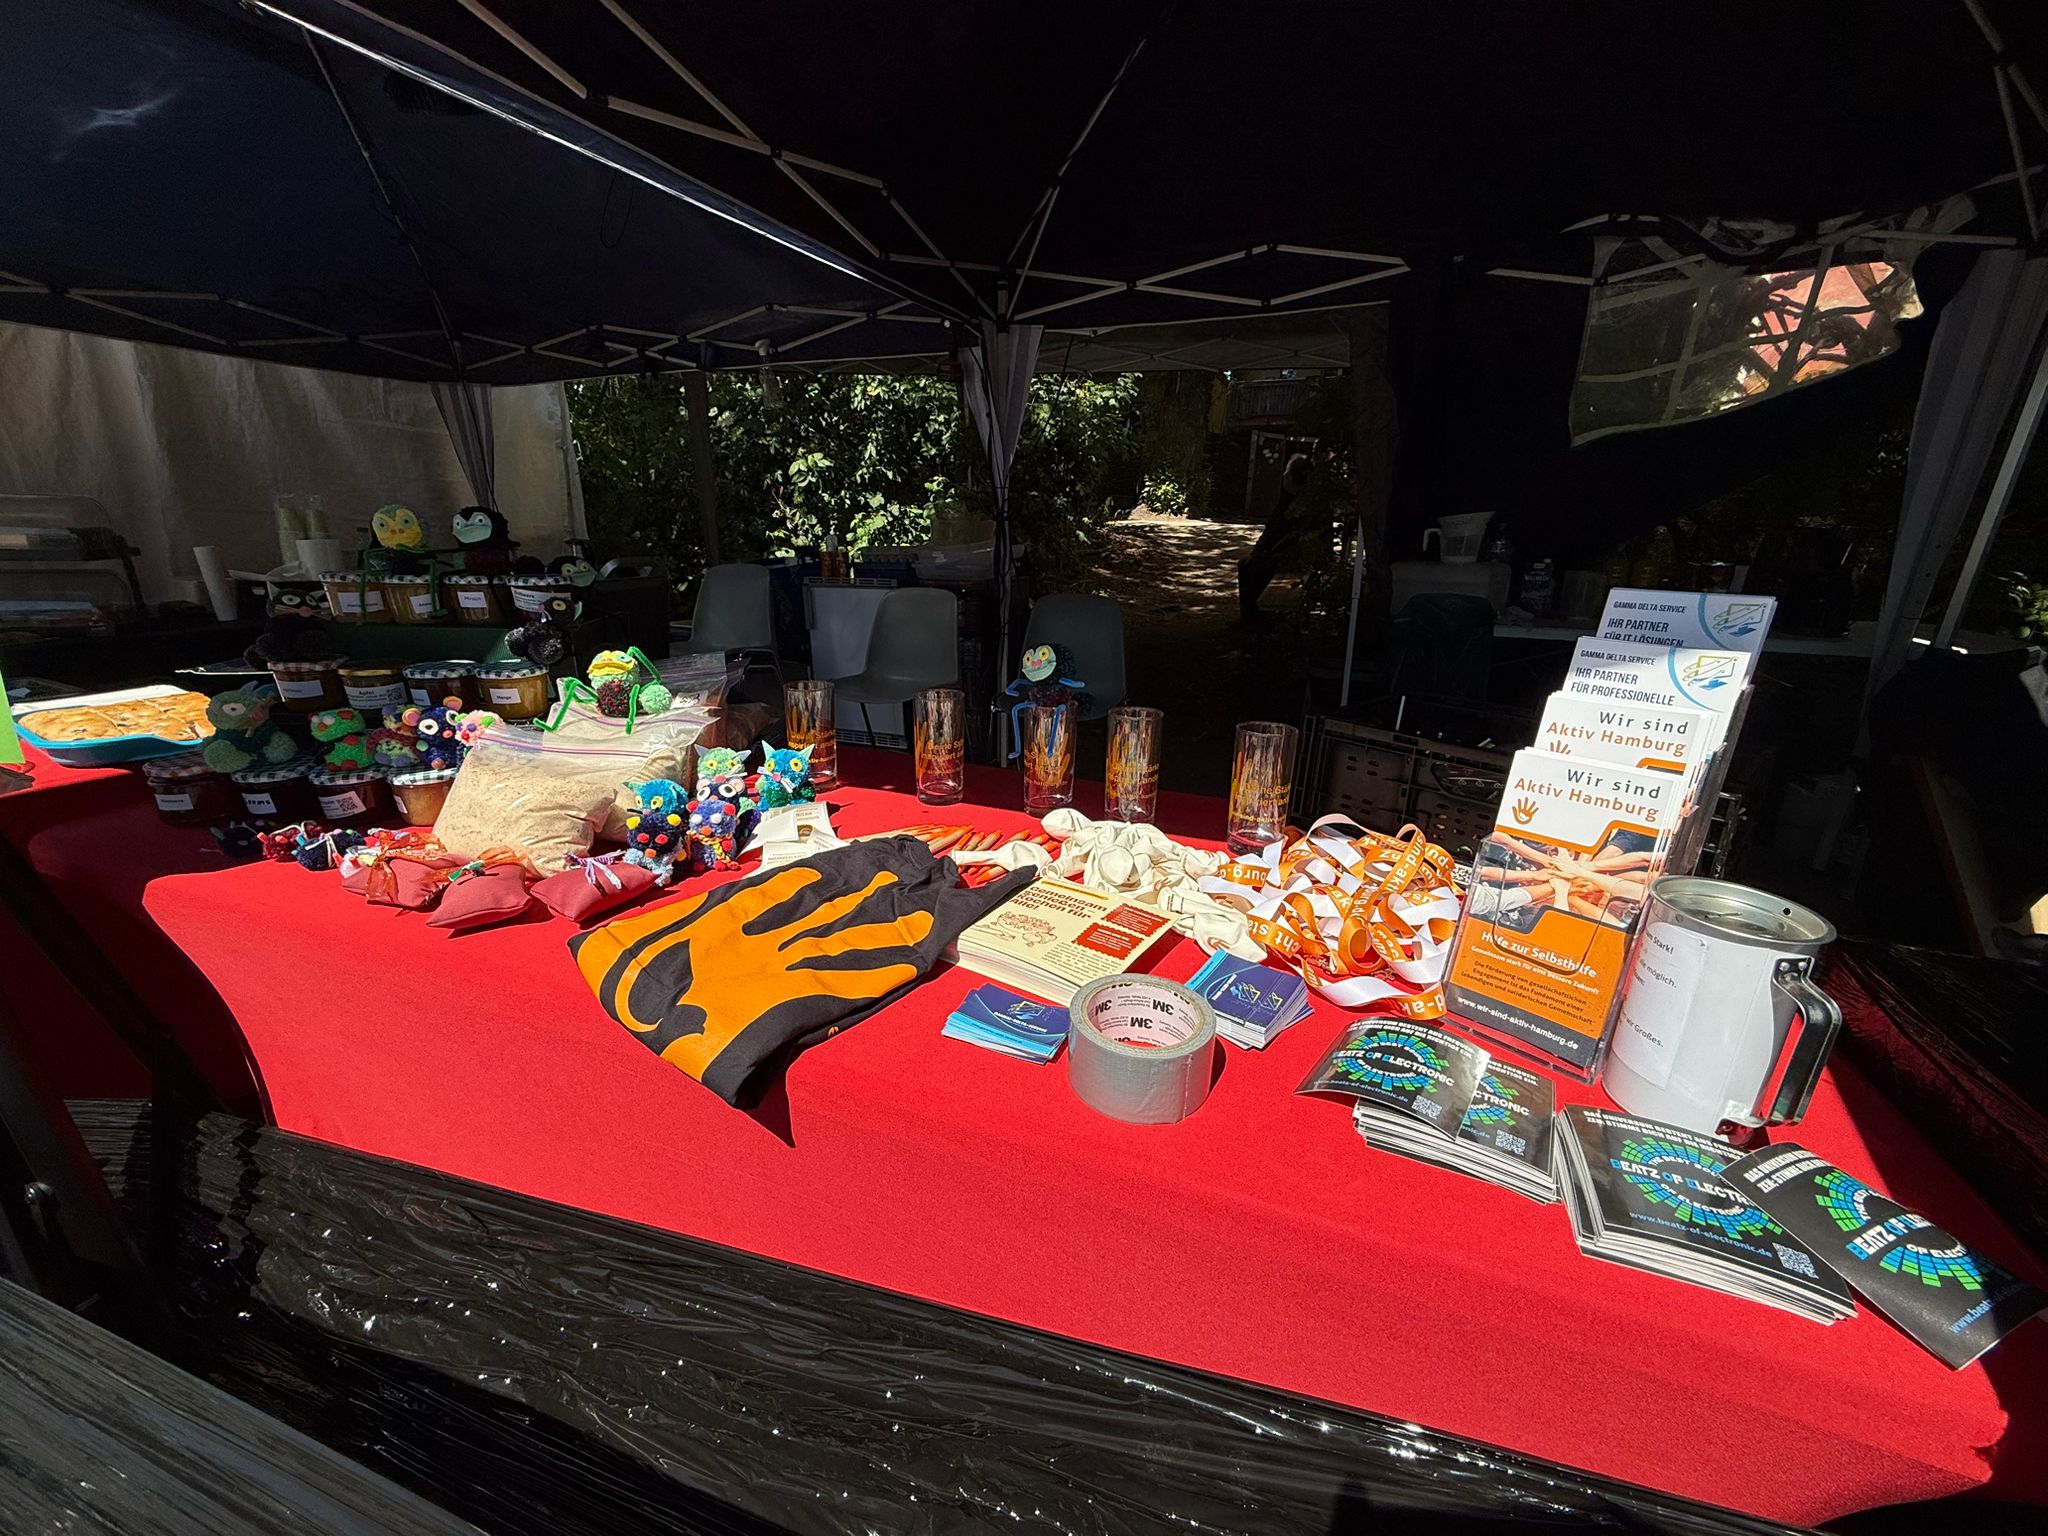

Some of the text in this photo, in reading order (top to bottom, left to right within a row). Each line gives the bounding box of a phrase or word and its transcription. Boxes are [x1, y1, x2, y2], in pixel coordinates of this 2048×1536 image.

[1613, 601, 1687, 614] GAMMA DELTA SERVICE
[1607, 618, 1669, 633] IHR PARTNER
[1604, 631, 1622, 642] FÜR
[1633, 634, 1684, 647] LÖSUNGEN
[1580, 649, 1656, 666] GAMMA DELTA SERVICE
[1575, 666, 1639, 685] IHR PARTNER
[1571, 682, 1675, 707] FÜR PROFESSIONELLE
[1600, 711, 1689, 735] Wir sind
[1547, 722, 1687, 757] Aktiv Hamburg
[1567, 769, 1661, 799] Wir sind
[1514, 778, 1659, 822] Aktiv Hamburg
[1009, 898, 1040, 911] Alle!
[1016, 893, 1092, 919] Kochen für
[1030, 886, 1108, 912] Gemeinsam
[1653, 936, 1674, 954] Stark!
[1471, 945, 1506, 962] Gemeinsam
[1506, 956, 1523, 968] stark
[1522, 961, 1533, 972] für
[1532, 966, 1548, 977] eine
[1573, 981, 1600, 995] Zukunft
[1510, 942, 1530, 955] zur
[1531, 948, 1597, 978] Selbsthilfe
[1474, 961, 1484, 969] Die
[1485, 963, 1516, 980] Förderung
[1517, 976, 1529, 985] von
[1647, 966, 1678, 988] möglich.
[1095, 999, 1112, 1016] 3M
[1152, 999, 1174, 1016] 3M
[1494, 983, 1507, 993] und
[1507, 987, 1548, 1008] solidarischen
[1519, 984, 1530, 993] das
[1530, 988, 1566, 1007] Fundament
[1130, 1016, 1153, 1029] 3M
[1428, 1029, 1444, 1039] AUS
[1458, 997, 1580, 1050] www.wir-sind-aktiv-hamburg.de
[1383, 1024, 1401, 1032] DICH
[1400, 1026, 1415, 1034] AUF
[1414, 1030, 1427, 1039] DIE
[1426, 1033, 1459, 1052] RICHTIGE
[1634, 1023, 1664, 1049] Großes.
[1331, 1049, 1455, 1087] BEATZ OF ELECTRONIC
[1583, 1110, 1601, 1119] DAS
[1601, 1112, 1654, 1129] UNIVERSUM
[1653, 1124, 1693, 1140] BESTEHT
[1692, 1136, 1713, 1147] AUS
[1605, 1120, 1641, 1133] STIMME
[1641, 1128, 1665, 1139] DICH
[1665, 1133, 1683, 1143] AUF
[1683, 1138, 1700, 1148] DIE
[1610, 1158, 1661, 1180] BEATZ
[1662, 1171, 1684, 1185] OF
[1648, 1156, 1664, 1167] THE
[1661, 1155, 1690, 1165] BEST
[1743, 1168, 1765, 1183] DAS
[1757, 1152, 1799, 1174] UNIVERSUM
[1771, 1165, 1804, 1185] STIMME
[1661, 1183, 1745, 1216] OF ELECTRONIC
[1629, 1211, 1773, 1258] www.beatz-of-electronic.de
[1846, 1225, 1897, 1261] BEATZ
[1883, 1217, 1909, 1236] OF
[1906, 1243, 1929, 1255] OF
